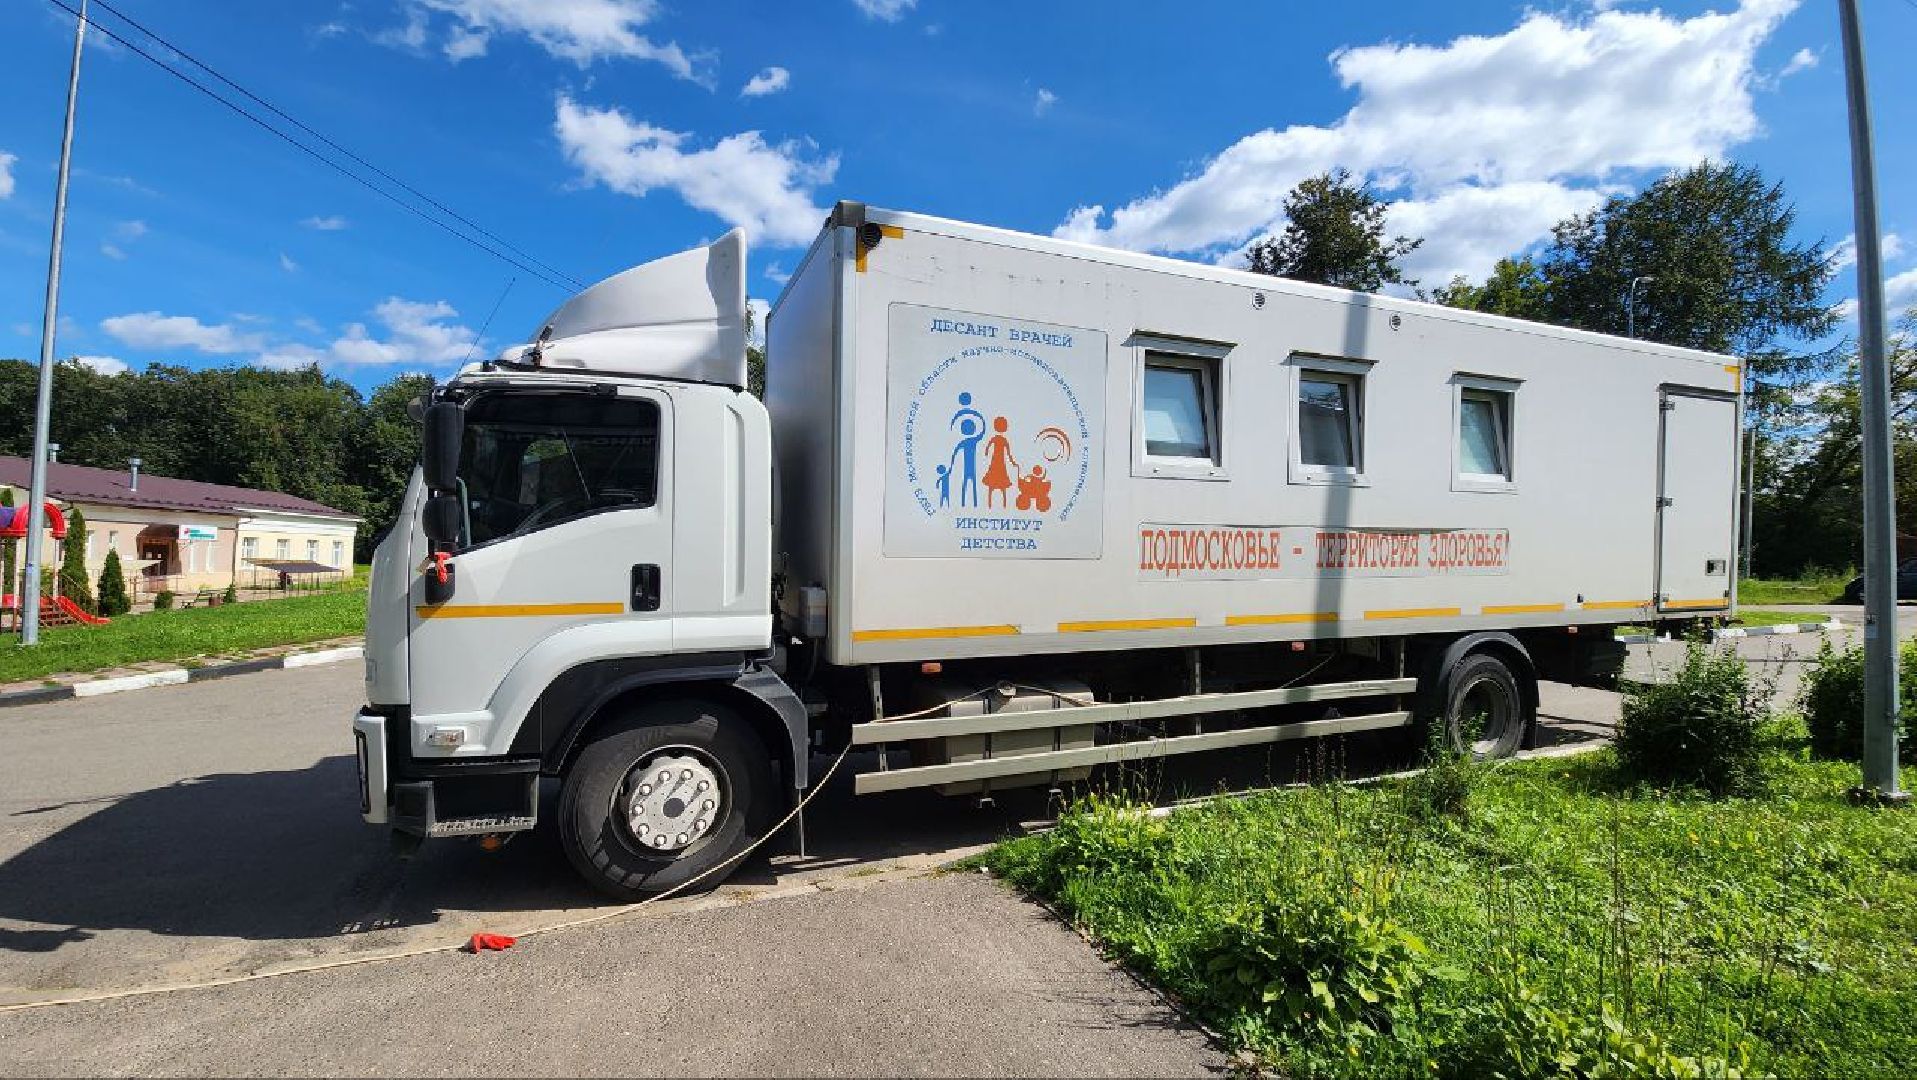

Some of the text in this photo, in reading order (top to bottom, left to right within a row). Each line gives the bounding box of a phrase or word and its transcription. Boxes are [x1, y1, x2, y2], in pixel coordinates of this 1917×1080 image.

[930, 319, 1073, 348] ДЕСАНТ ВРАЧЕЙ
[919, 355, 958, 396] области
[914, 488, 937, 517] ГБУЗ
[955, 517, 1043, 531] ИНСТИТУТ
[961, 538, 1038, 551] ДЕТСТВА
[1140, 529, 1281, 576] ПОДМОСКОВЬЕ
[1316, 532, 1419, 569] ТЕРРИТОРИЯ
[1427, 533, 1511, 573] ЗДОРОВЬЯ!
